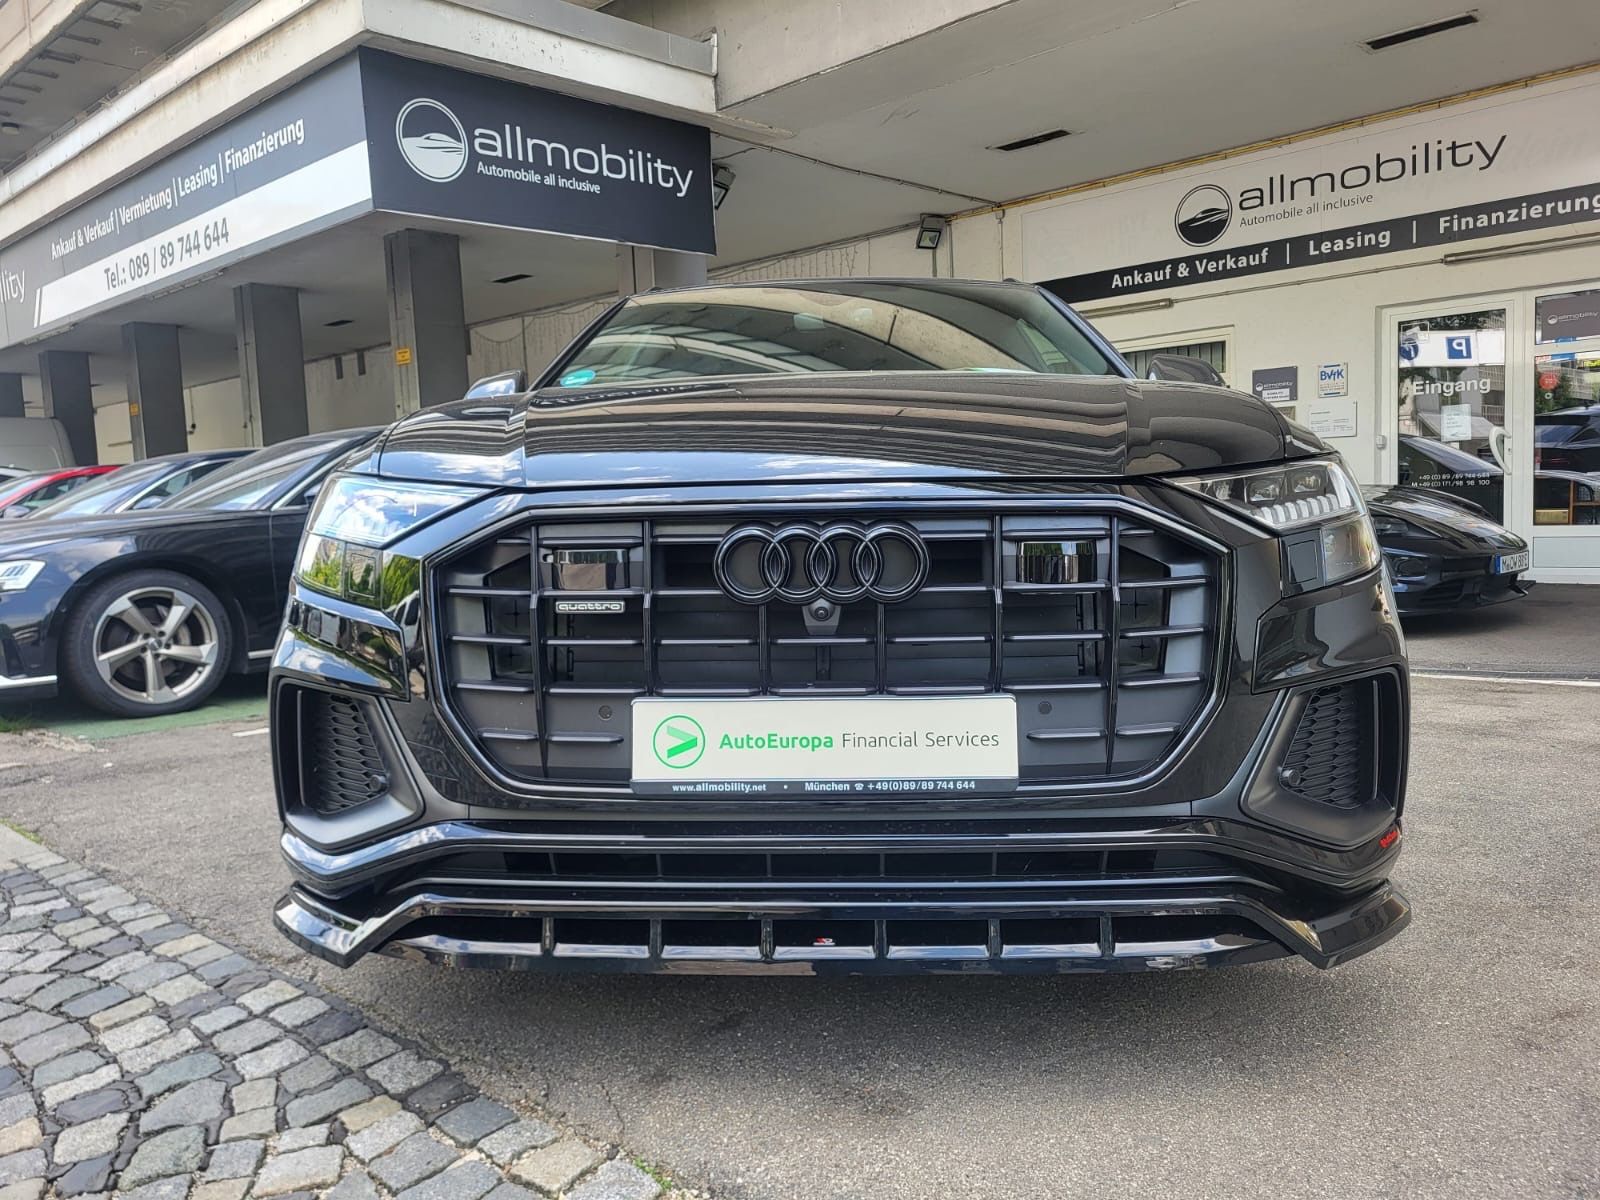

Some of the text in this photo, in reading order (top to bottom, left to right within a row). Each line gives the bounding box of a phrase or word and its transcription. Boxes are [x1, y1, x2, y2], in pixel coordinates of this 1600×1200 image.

[473, 123, 694, 197] allmobility
[1238, 134, 1507, 211] allmobility
[51, 231, 77, 260] Ankauf
[76, 229, 85, 247] &
[84, 212, 116, 243] Verkauf
[119, 187, 172, 226] Vermietung
[178, 162, 218, 197] Leasing
[224, 118, 305, 174] Finanzierung
[477, 161, 601, 194] Automobile all inclusive
[1240, 194, 1374, 227] Automobile all inclusive
[104, 261, 127, 291] Tel.:
[128, 252, 150, 281] 089
[160, 241, 175, 269] 89
[177, 229, 201, 263] 744
[203, 217, 230, 251] 644
[1111, 264, 1172, 289] Ankauf
[1177, 262, 1190, 278] &
[1195, 247, 1269, 275] Verkauf
[1308, 228, 1391, 256] Leasing
[1414, 378, 1490, 396] Eingang
[558, 603, 621, 611] quattro
[719, 731, 1000, 752] AutoEuropa Financial Services
[672, 780, 976, 793] www.allmobility.net München +49(0)89/89 744 644
